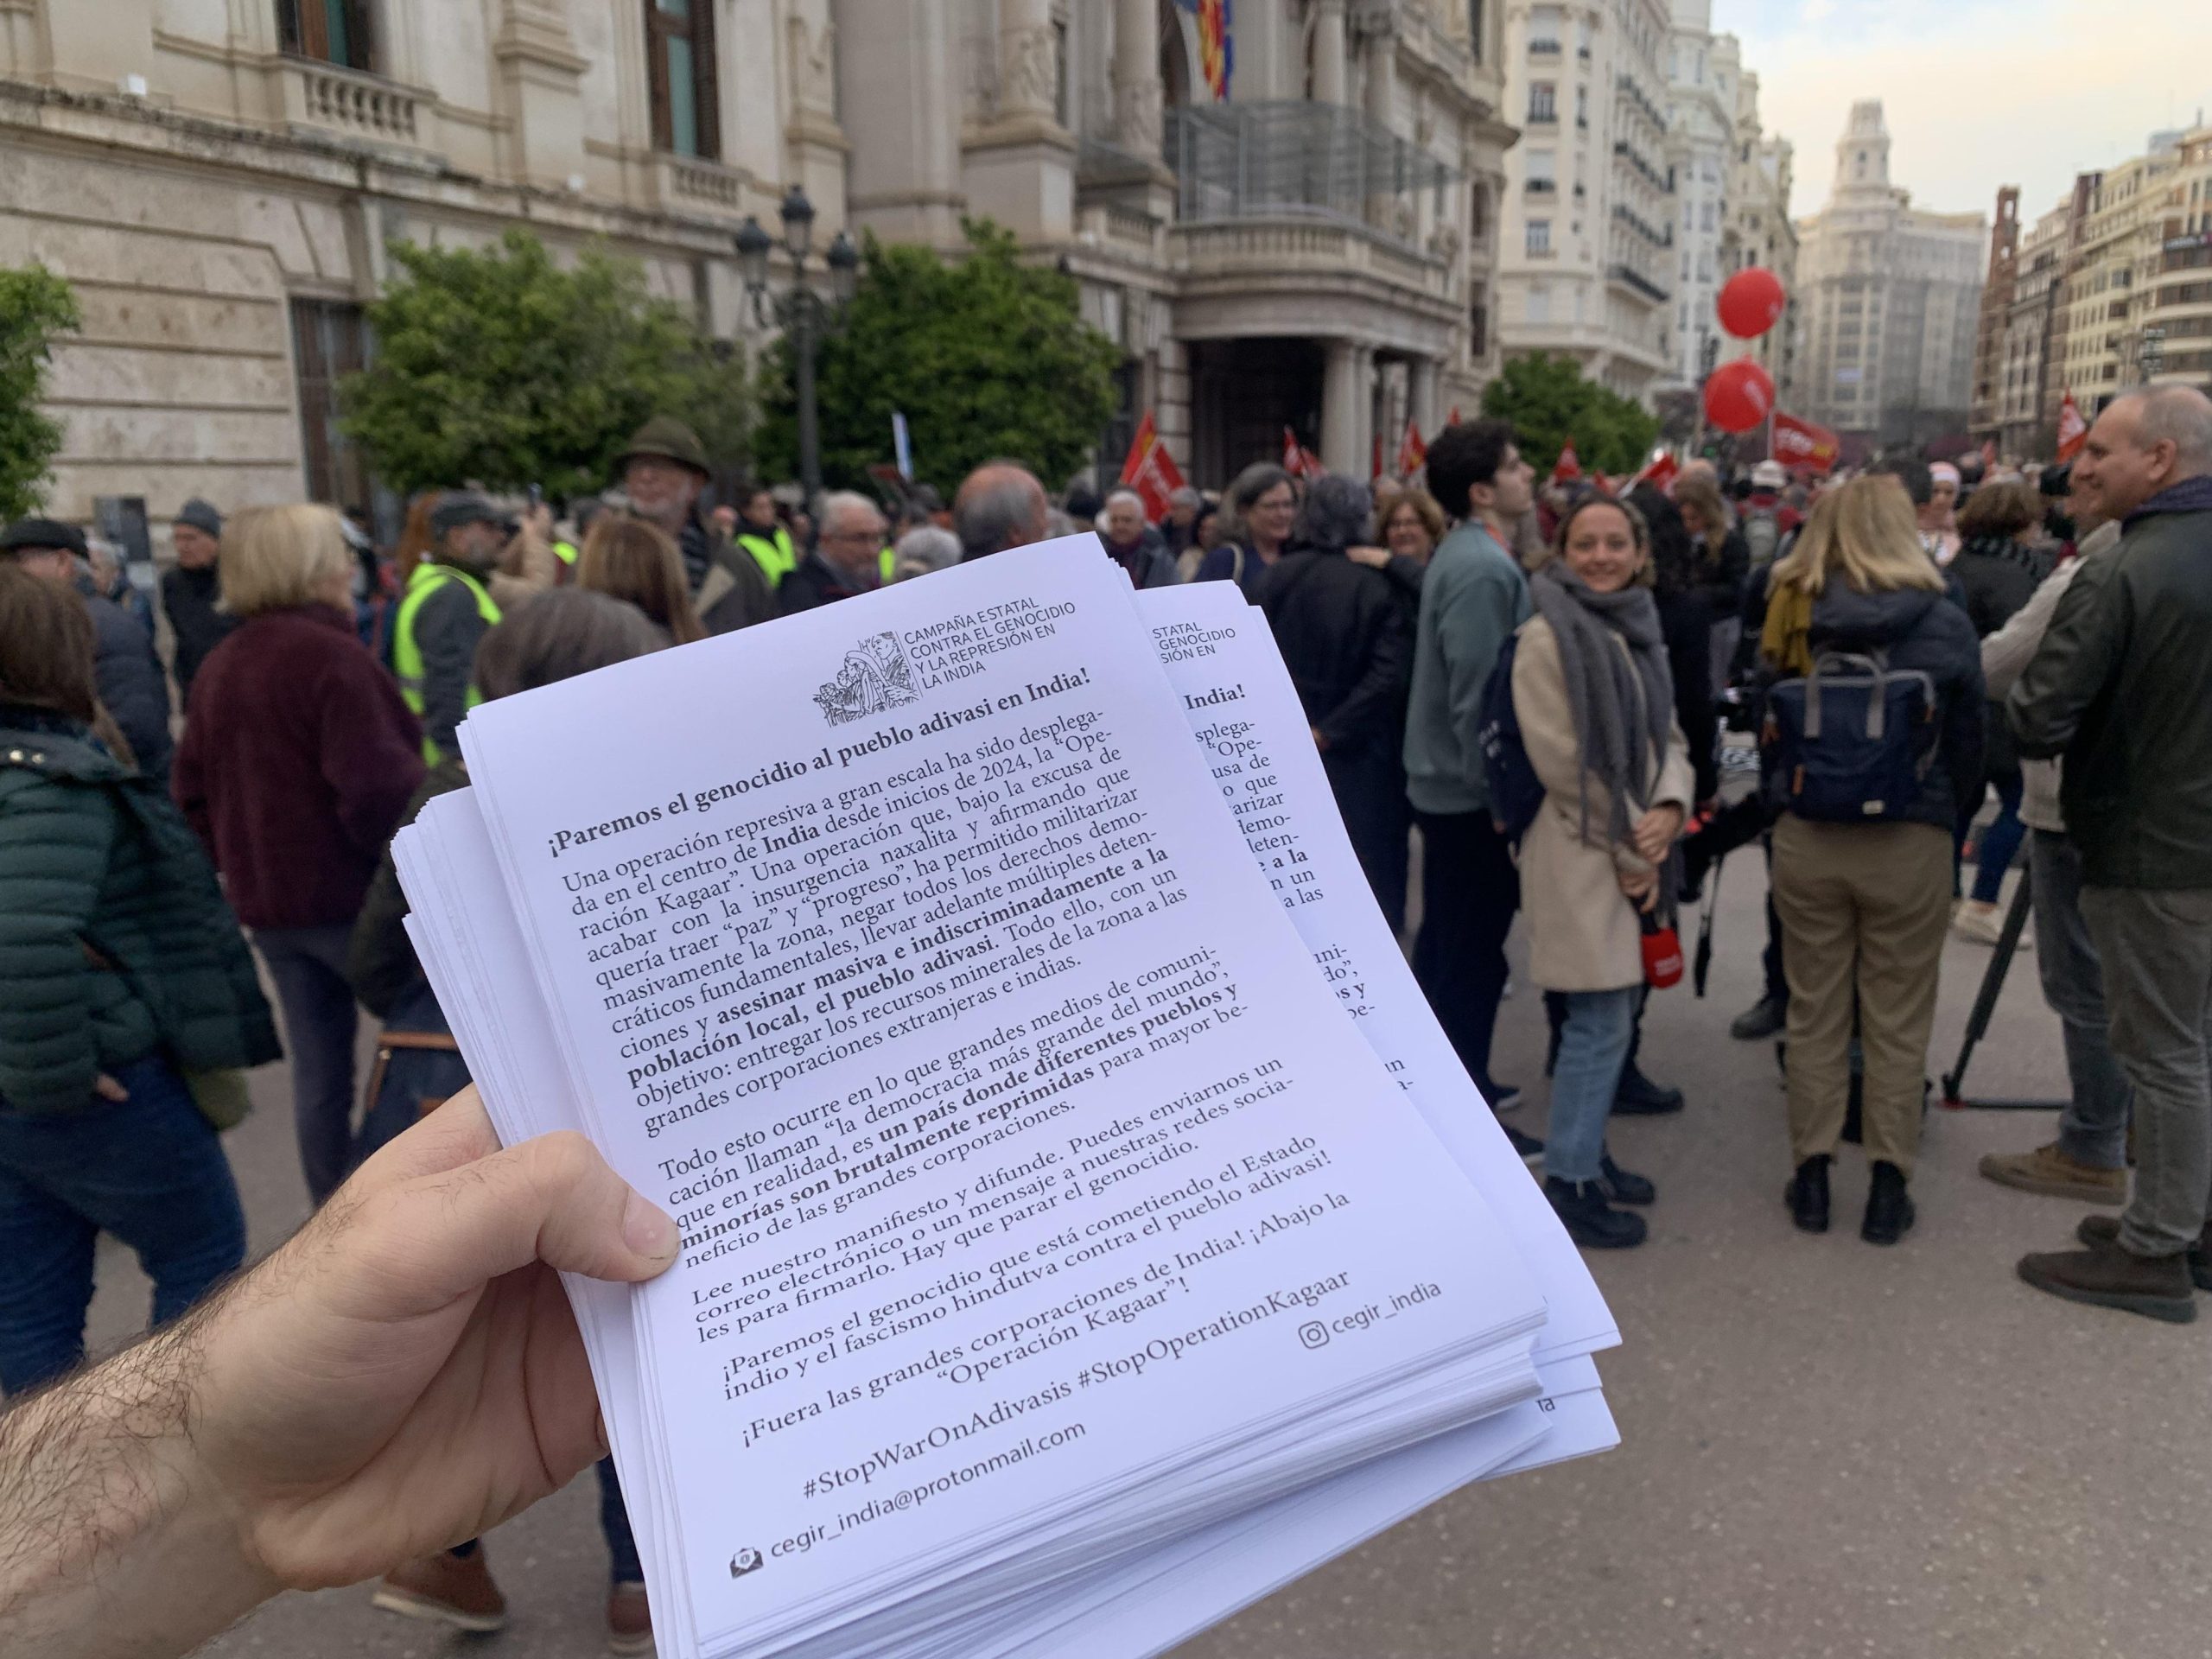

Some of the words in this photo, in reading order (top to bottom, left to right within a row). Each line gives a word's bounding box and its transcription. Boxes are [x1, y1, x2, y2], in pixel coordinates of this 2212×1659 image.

[904, 614, 976, 644] CAMPAÑA
[976, 597, 1039, 623] ESTATAL
[910, 632, 972, 658] CONTRA
[973, 626, 993, 640] EL
[995, 601, 1075, 633] GENOCIDIO
[914, 661, 924, 674] Y
[927, 656, 948, 671] LA
[948, 629, 1033, 664] REPRESIÓN
[1034, 623, 1055, 639] EN
[922, 674, 942, 689] LA
[944, 660, 986, 682] INDIA
[1152, 622, 1202, 639] STATAL
[1159, 628, 1235, 650] GENOCIDIO
[1196, 644, 1215, 656] EN
[549, 806, 662, 857] ¡Paremos
[668, 792, 690, 814] el
[695, 760, 807, 812] genocidio
[812, 747, 834, 769] al
[836, 727, 912, 767] pueblo
[918, 698, 994, 735] adivasi
[997, 694, 1023, 709] en
[1025, 667, 1090, 701] India!
[1183, 683, 1245, 709] India!
[1208, 734, 1262, 758] “Ope-
[1249, 753, 1270, 769] de
[562, 869, 610, 891] Una
[615, 832, 721, 878] operación
[724, 803, 817, 842] represiva
[822, 798, 834, 810] a
[838, 782, 883, 810] gran
[887, 759, 944, 788] escala
[944, 752, 972, 769] ha
[976, 736, 1014, 760] sido
[1020, 711, 1103, 745] desplega-
[579, 906, 649, 939] ración
[655, 870, 743, 913] Kagaar”.
[750, 859, 796, 880] Una
[804, 822, 902, 867] operación
[911, 809, 951, 833] que,
[955, 790, 999, 812] bajo
[1003, 779, 1025, 797] la
[1032, 760, 1093, 787] excusa
[1100, 747, 1121, 764] de
[1244, 775, 1277, 795] que
[1272, 857, 1284, 868] a
[1287, 849, 1308, 863] la
[588, 929, 657, 962] acabar
[672, 912, 710, 934] con
[720, 899, 741, 918] la
[752, 858, 869, 907] insurgencia
[880, 830, 957, 864] naxalita
[966, 820, 977, 839] y
[990, 783, 1085, 826] afirmando
[1096, 769, 1130, 792] que
[596, 950, 664, 990] quería
[669, 934, 718, 961] traer
[723, 906, 778, 945] “paz”
[785, 906, 797, 926] y
[802, 863, 911, 918] “progreso”,
[912, 859, 940, 876] ha
[943, 823, 1038, 872] permitido
[1042, 789, 1137, 831] militarizar
[603, 952, 744, 1010] masivamente
[748, 941, 771, 959] la
[777, 924, 833, 950] zona,
[840, 899, 894, 928] negar
[903, 877, 957, 905] todos
[961, 865, 991, 884] los
[999, 833, 1082, 870] derechos
[1089, 812, 1147, 838] demo-
[613, 995, 695, 1033] cráticos
[700, 940, 858, 1003] fundamentales,
[860, 916, 917, 945] llevar
[924, 886, 1003, 923] adelante
[1007, 852, 1095, 893] múltiples
[1099, 832, 1156, 857] deten-
[1283, 897, 1295, 907] a
[1296, 888, 1323, 904] las
[1289, 870, 1315, 884] un
[620, 1025, 689, 1058] ciones
[695, 1017, 708, 1037] y
[717, 982, 805, 1024] asesinar
[813, 954, 887, 989] masiva
[894, 947, 906, 958] e
[911, 865, 1125, 953] indiscriminadamente
[1132, 859, 1144, 870] a
[1146, 848, 1168, 864] la
[645, 1090, 729, 1138] grandes
[735, 1032, 882, 1096] corporaciones
[887, 987, 996, 1038] extranjeras
[1002, 981, 1013, 992] e
[1015, 956, 1081, 988] indias.
[670, 1166, 740, 1205] cación
[744, 1135, 820, 1173] llaman
[824, 1117, 857, 1135] “la
[865, 1067, 982, 1123] democracia
[988, 1046, 1029, 1072] más
[1037, 1015, 1104, 1059] grande
[1111, 996, 1141, 1020] del
[1146, 961, 1228, 1006] mundo”,
[681, 1198, 784, 1250] minorías
[791, 1179, 830, 1204] son
[833, 1120, 971, 1184] brutalmente
[976, 1067, 1094, 1125] reprimidas
[1098, 1047, 1144, 1077] para
[1148, 1018, 1211, 1052] mayor
[1212, 1007, 1247, 1022] be-
[686, 1232, 760, 1268] neficio
[766, 1217, 792, 1235] de
[797, 1203, 827, 1224] las
[834, 1166, 916, 1213] grandes
[923, 1101, 1074, 1170] corporaciones.
[692, 1282, 732, 1305] Lee
[741, 1248, 826, 1287] nuestro
[835, 1198, 948, 1251] manifiesto
[955, 1189, 966, 1206] y
[976, 1152, 1063, 1192] difunde.
[1067, 1116, 1143, 1154] Puedes
[1150, 1072, 1249, 1120] enviarnos
[1254, 1059, 1283, 1076] un
[698, 1323, 728, 1343] les
[736, 1302, 789, 1333] para
[795, 1264, 894, 1306] firmarlo.
[900, 1240, 945, 1266] Hay
[954, 1223, 994, 1247] que
[999, 1195, 1057, 1231] parar
[1065, 1181, 1083, 1199] el
[1089, 1142, 1198, 1195] genocidio.
[723, 1326, 834, 1382] ¡Paremos
[842, 1311, 861, 1331] el
[869, 1271, 981, 1326] genocidio
[989, 1251, 1030, 1278] que
[1037, 1227, 1079, 1255] está
[1085, 1179, 1213, 1236] cometiendo
[1220, 1163, 1238, 1181] el
[1241, 1137, 1315, 1173] Estado
[1332, 1283, 1441, 1332] cegir_india
[743, 1402, 822, 1447] ¡Fuera
[827, 1386, 861, 1408] las
[868, 1346, 963, 1397] grandes
[971, 1277, 1137, 1351] corporaciones
[1144, 1263, 1171, 1281] de
[1174, 1230, 1244, 1268] India!
[1249, 1204, 1323, 1243] ¡Abajo
[1325, 1193, 1350, 1208] la
[804, 1382, 1071, 1498] #StopWarOnAdivasis
[1078, 1272, 1349, 1388] #StopOperationKagaar
[938, 1325, 1078, 1382] “Operación
[1084, 1276, 1189, 1331] Kagaar”!
[772, 1423, 1085, 1557] cegir_india@protonmail.com
